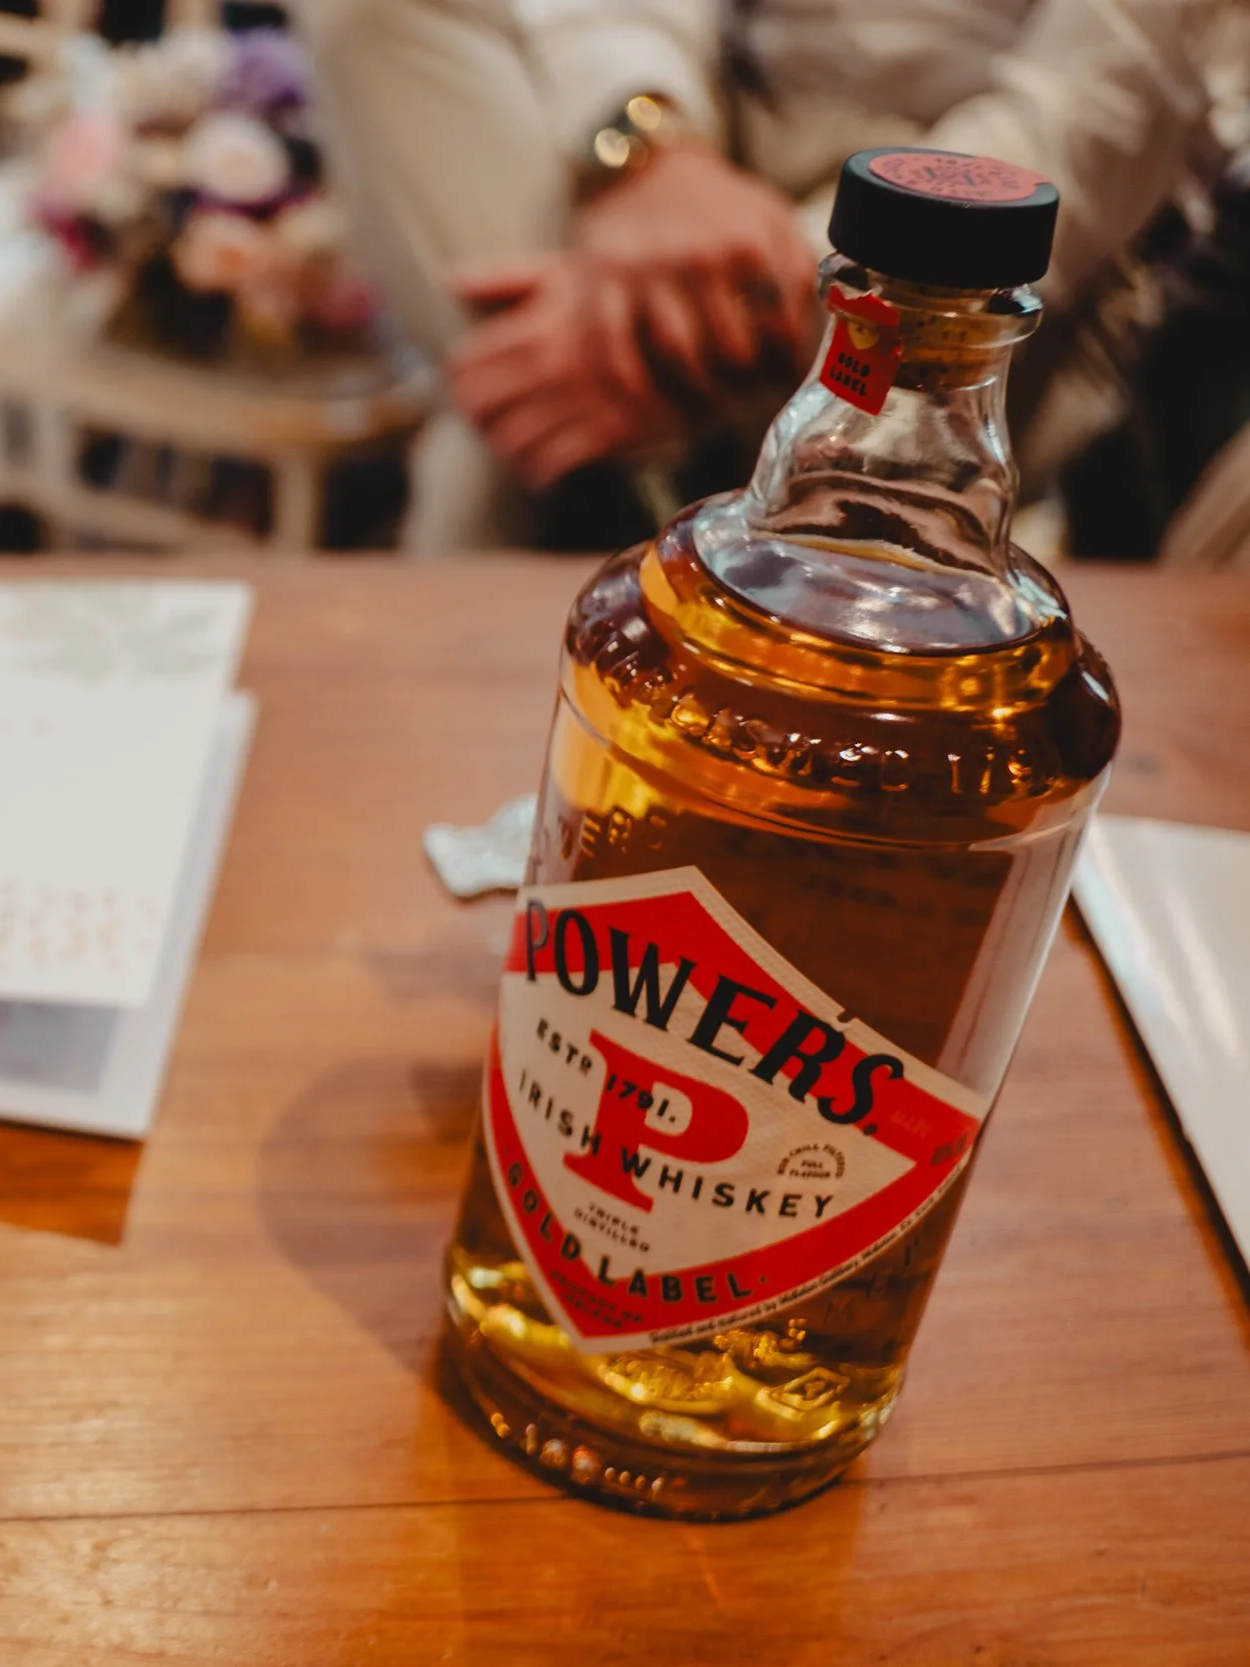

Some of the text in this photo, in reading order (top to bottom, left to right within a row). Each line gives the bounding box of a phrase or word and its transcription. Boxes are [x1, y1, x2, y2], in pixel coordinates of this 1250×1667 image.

[829, 365, 867, 396] LABEL
[838, 352, 870, 377] GOLD
[519, 1068, 602, 1157] IRISH
[622, 1147, 834, 1219] WHISKEY
[562, 1028, 750, 1213] P
[508, 1162, 582, 1260] GOLD
